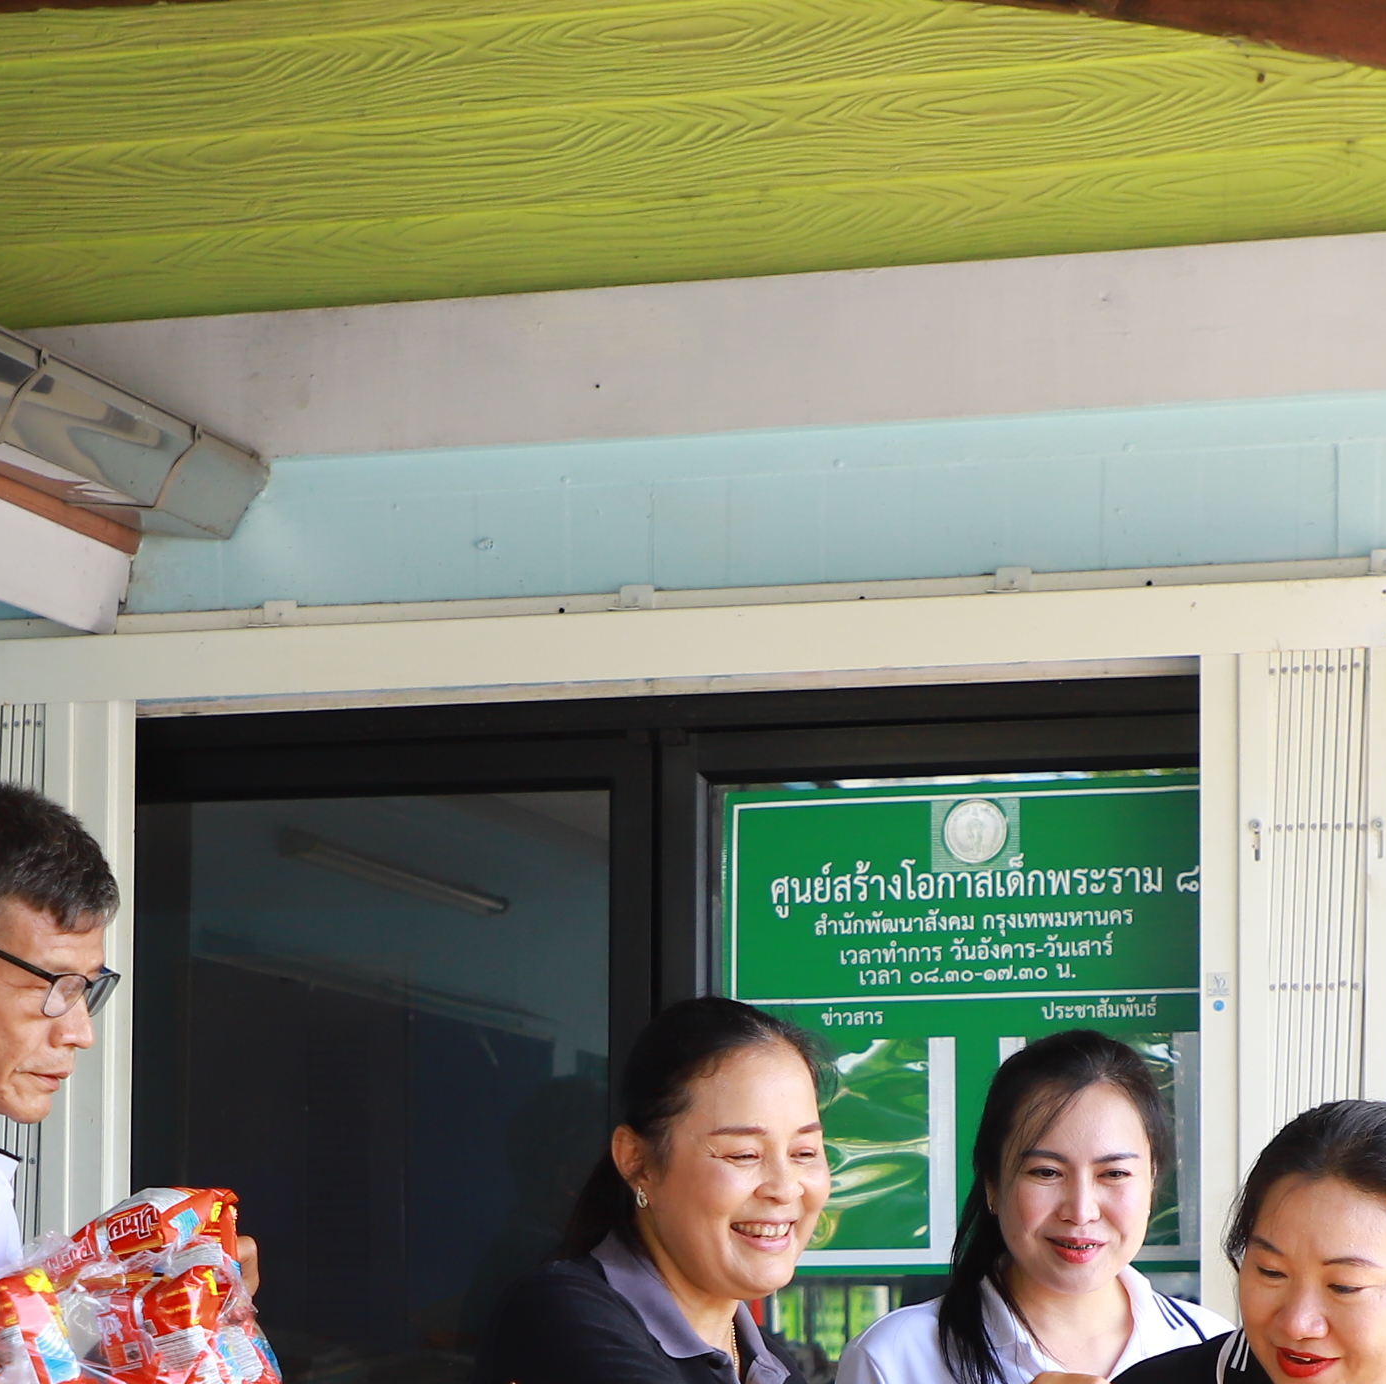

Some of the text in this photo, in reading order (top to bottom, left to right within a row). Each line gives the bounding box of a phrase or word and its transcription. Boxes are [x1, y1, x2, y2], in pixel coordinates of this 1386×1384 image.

[771, 854, 1163, 918] ศูนย์สร้างโอกาสเด็กพระราม
[814, 906, 1134, 937] สำนักพัฒนาสังคม กรุงเทพมหานคร
[839, 931, 1115, 966] เวลาทำการ วันอังคาร-วันเสาร์
[859, 966, 901, 986] เวลา
[1057, 961, 1077, 980] น.
[821, 1007, 884, 1028] ข่าวสาร
[1042, 996, 1158, 1020] ประชาสัมพันธ์
